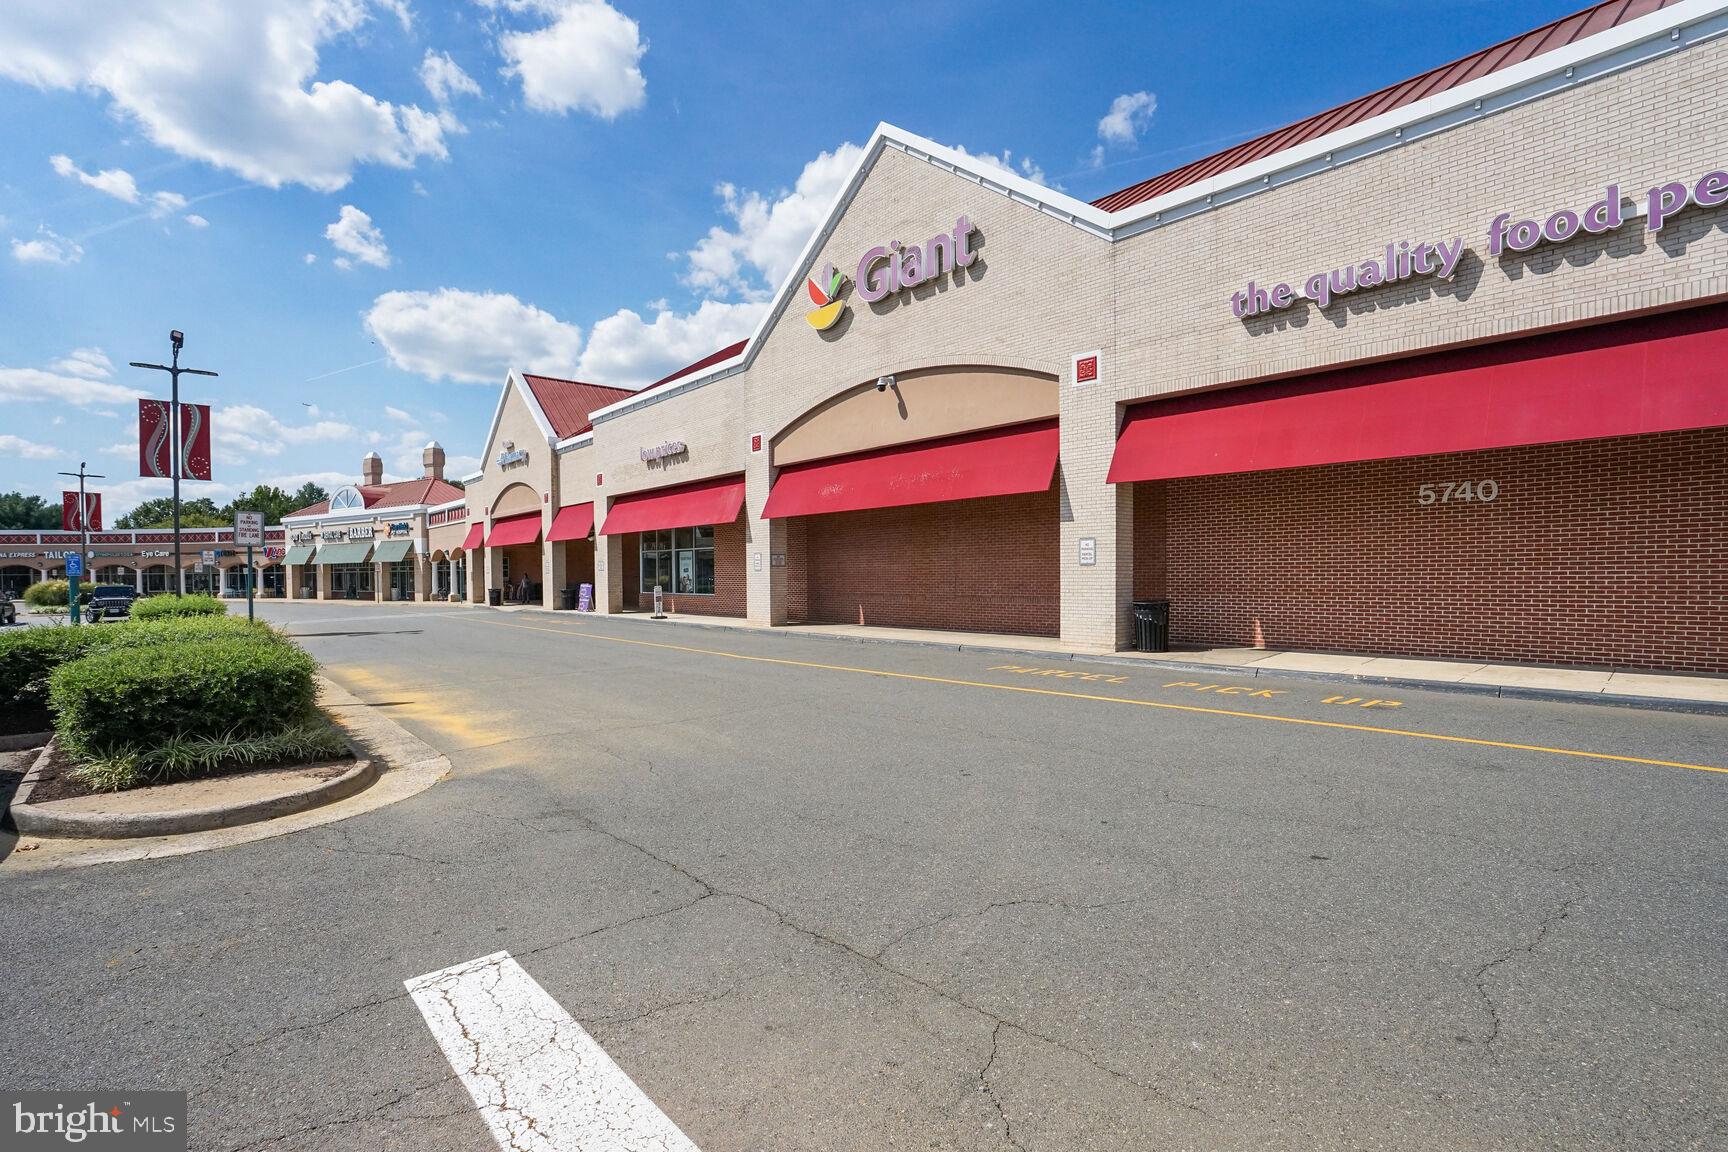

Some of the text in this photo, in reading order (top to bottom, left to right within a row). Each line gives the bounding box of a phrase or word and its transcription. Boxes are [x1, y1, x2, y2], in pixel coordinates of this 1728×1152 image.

[856, 214, 976, 303] Giant
[1230, 280, 1295, 318] the
[1304, 237, 1464, 308] quality
[1488, 183, 1624, 257] food
[1418, 479, 1499, 505] 5740
[141, 550, 153, 559] Eye
[986, 665, 1403, 708] PARCEL PICK UP
